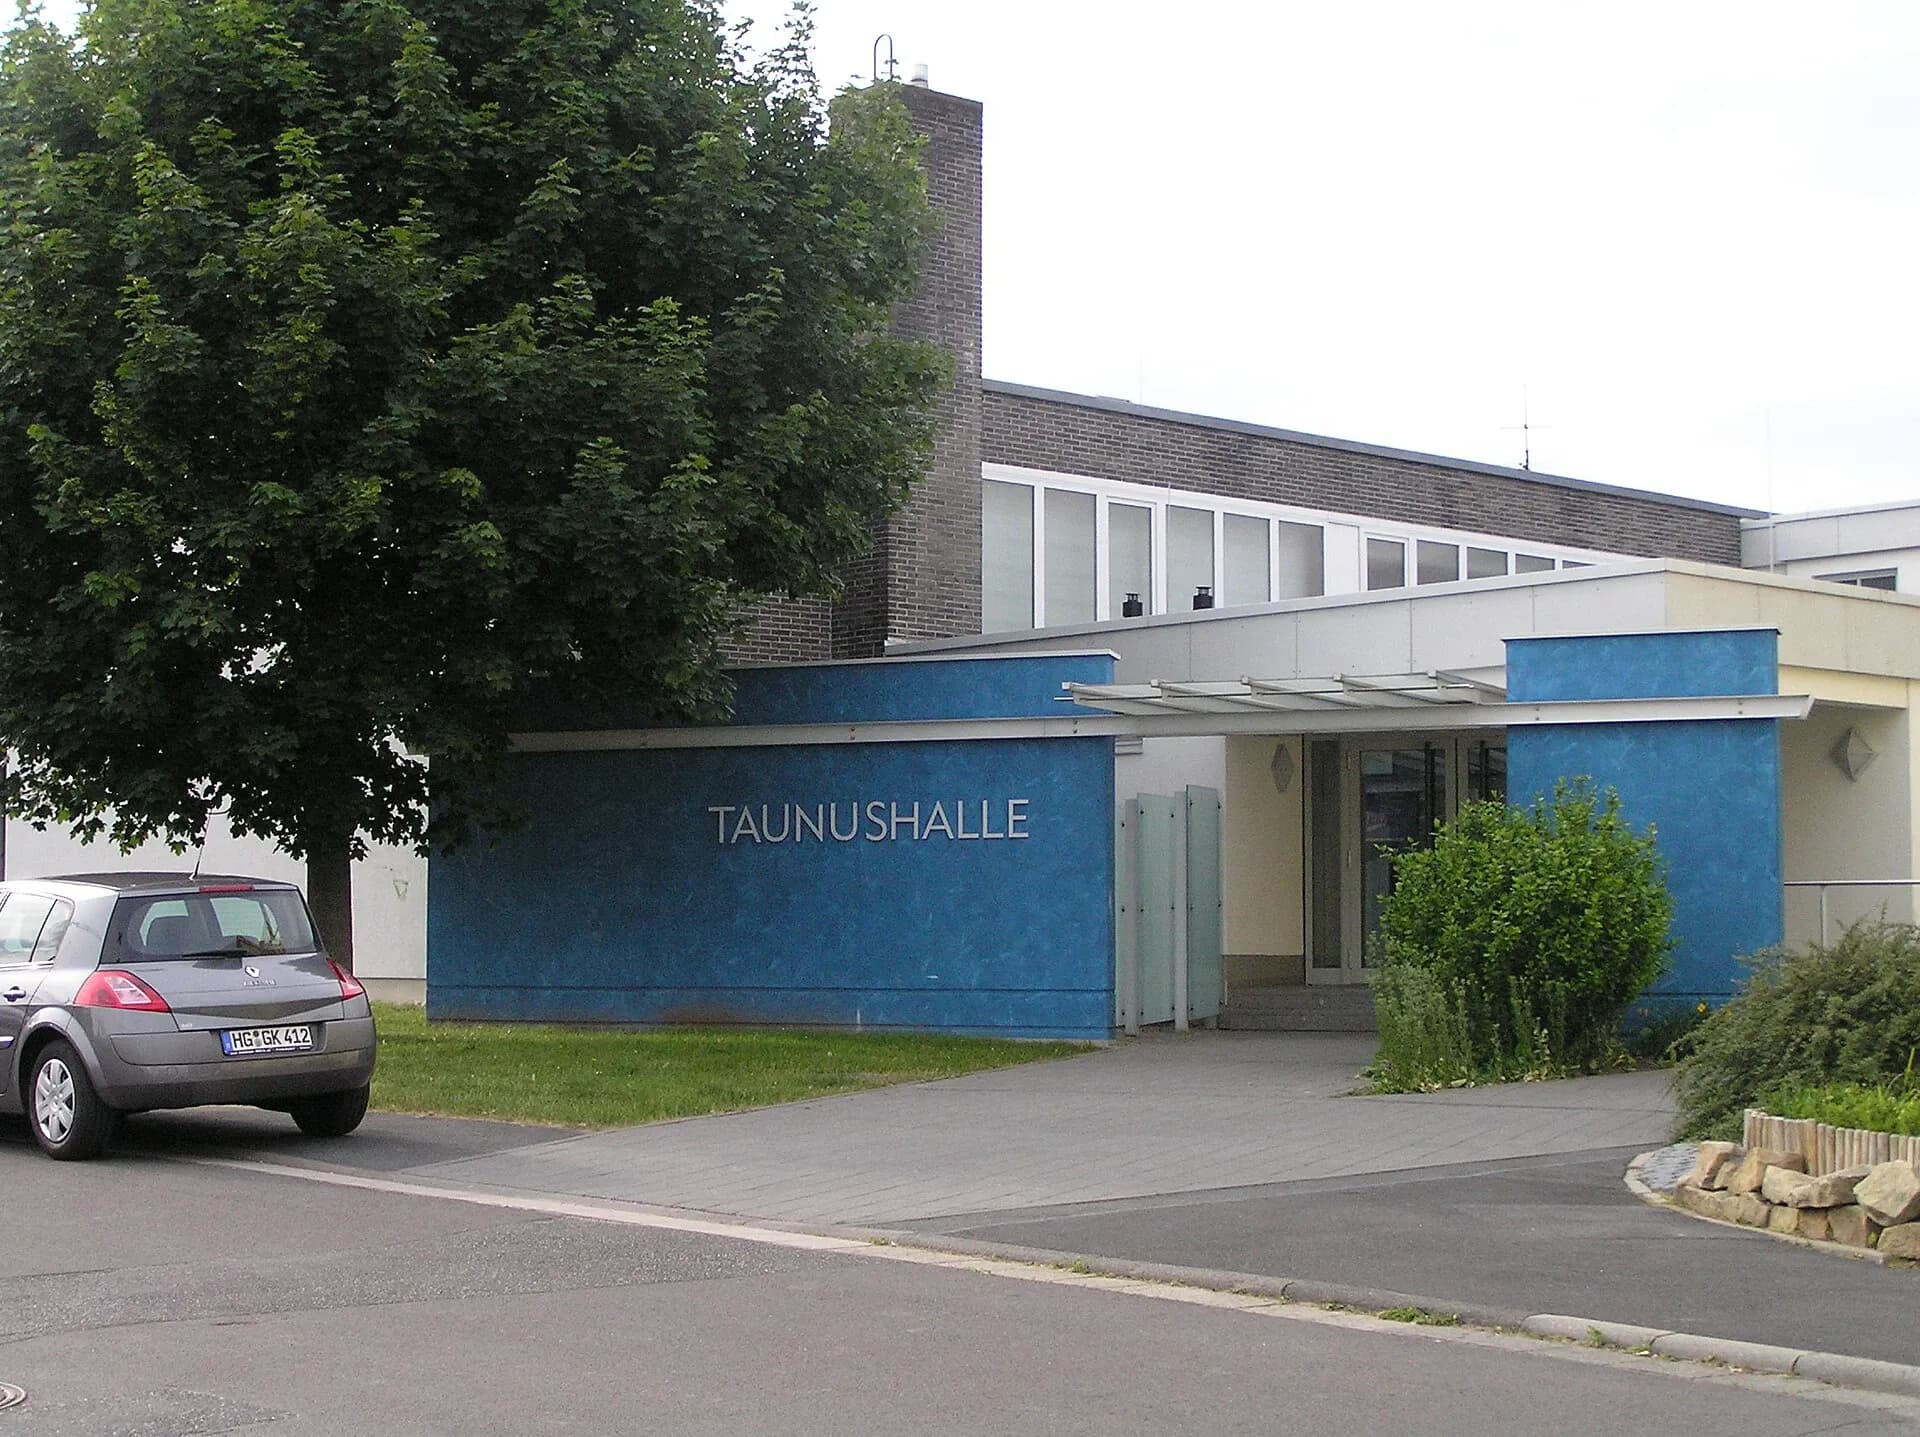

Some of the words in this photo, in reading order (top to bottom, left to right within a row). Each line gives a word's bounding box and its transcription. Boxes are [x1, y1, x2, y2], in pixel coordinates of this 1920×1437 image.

[708, 799, 1029, 843] TAUNUSHALLE
[232, 1031, 254, 1048] HG
[262, 1030, 281, 1047] GK
[284, 1028, 310, 1044] 412
